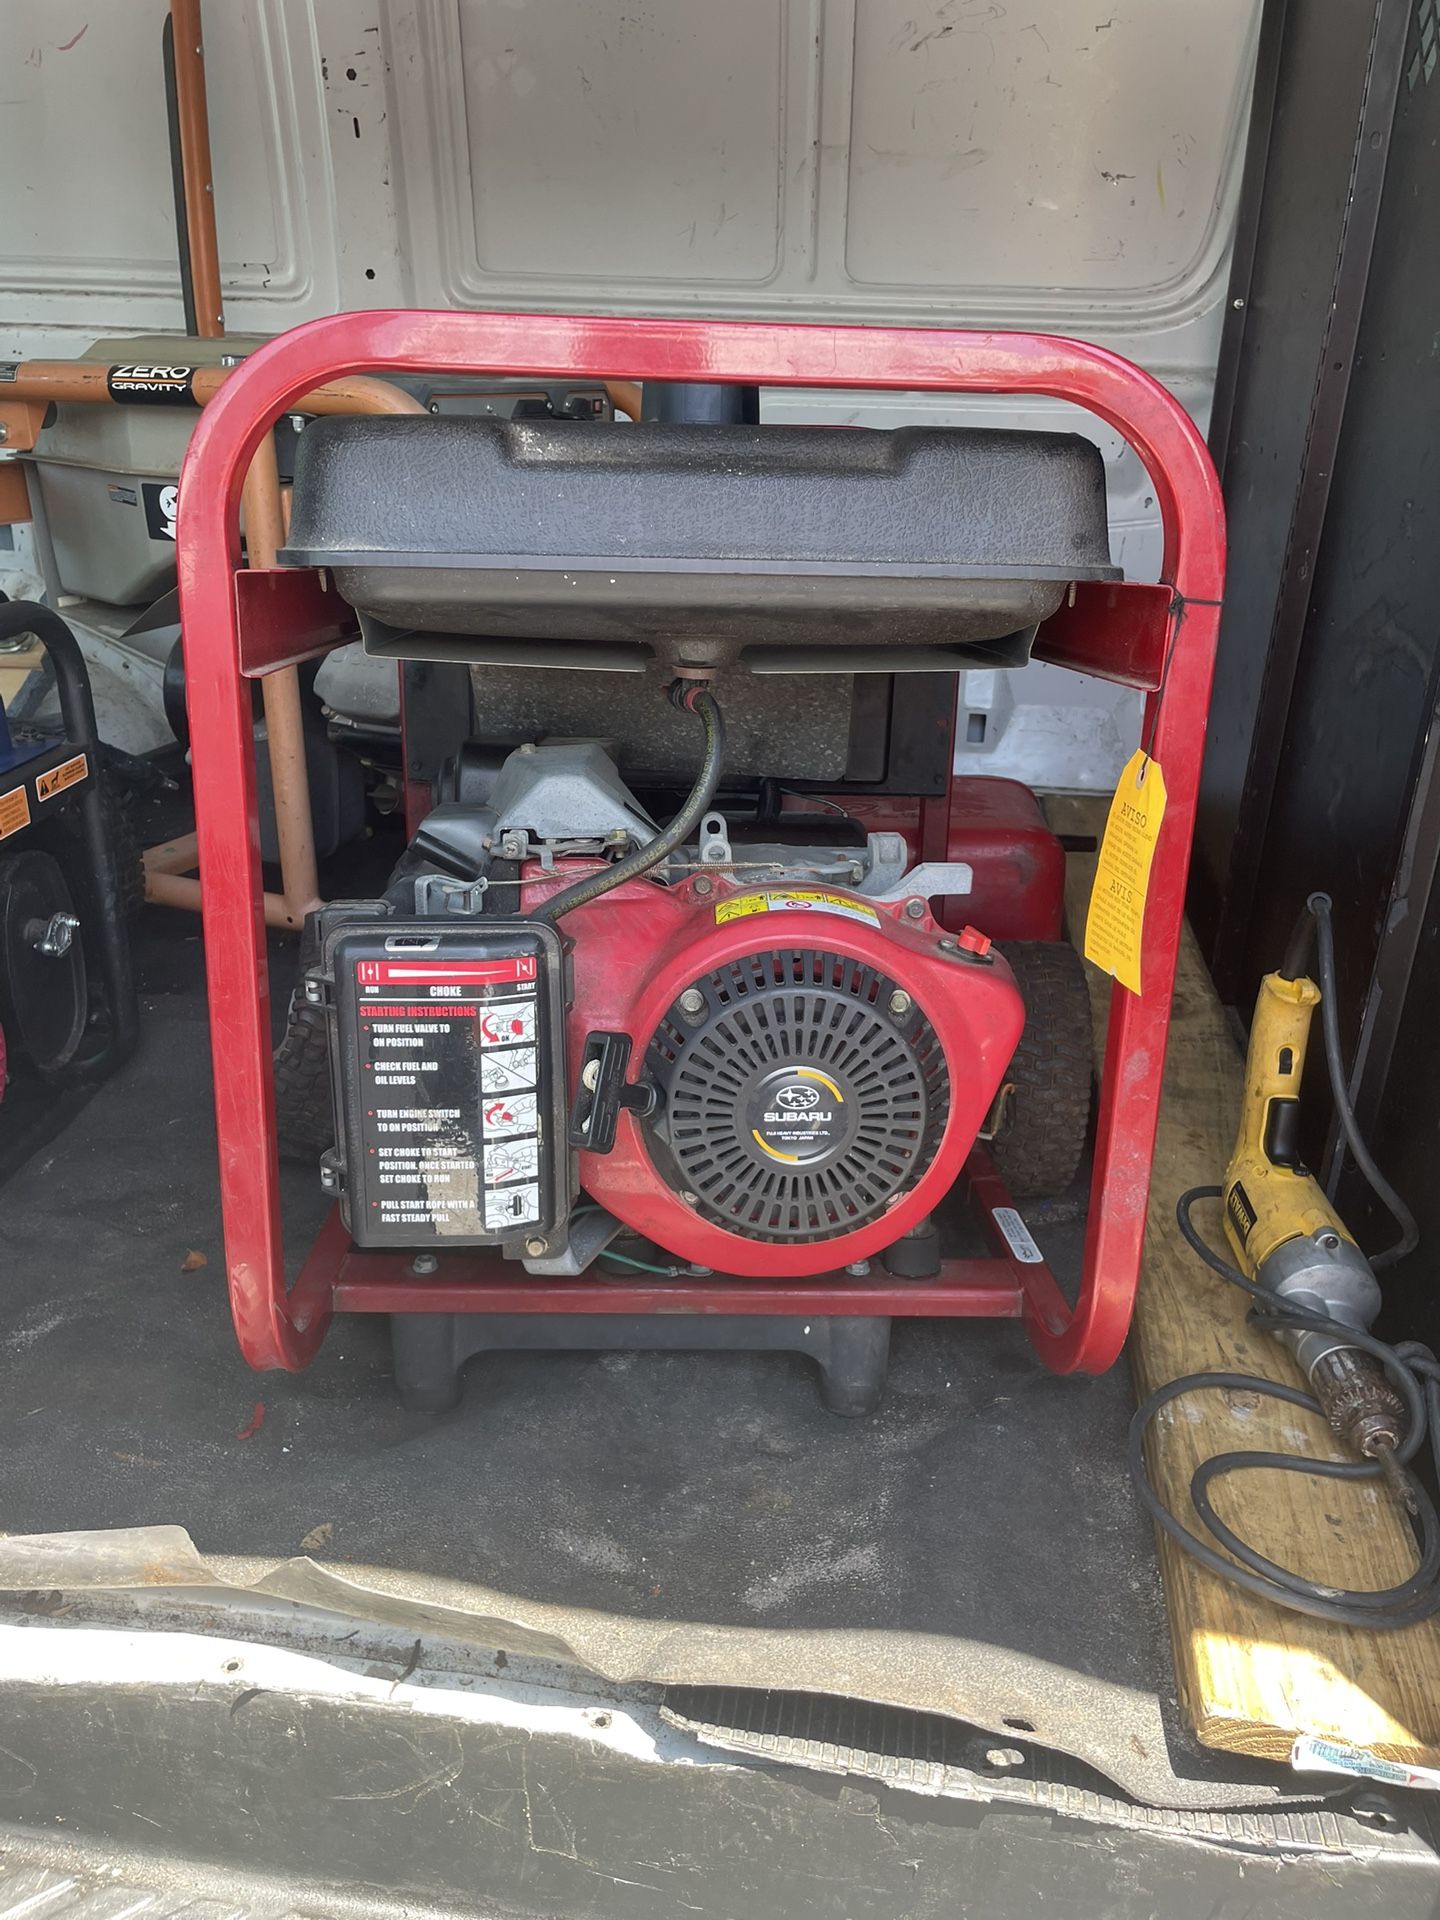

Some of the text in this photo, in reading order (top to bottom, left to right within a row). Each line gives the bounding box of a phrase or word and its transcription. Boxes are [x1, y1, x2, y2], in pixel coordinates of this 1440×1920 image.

[112, 364, 191, 379] ZERO
[112, 382, 187, 392] GRAVITY
[1120, 802, 1147, 828] AVISO
[1109, 879, 1133, 904] AVIS
[365, 982, 536, 997] RUN CHOKE START
[360, 1006, 477, 1017] STARTING INSTRUCTIONS
[372, 1024, 450, 1033] TURN FUEL VALVE TO
[373, 1038, 424, 1047] ON POSITION
[374, 1062, 438, 1071] CHECK FUEL AND
[375, 1076, 416, 1085] OIL LEVELS
[376, 1109, 460, 1118] TURN ENGINE SWITCH
[763, 1112, 832, 1122] SUBARU
[377, 1123, 438, 1132] TO ON POSITION
[378, 1148, 458, 1157] SET CHOKE TO START
[379, 1161, 475, 1170] POSITION. ONCE STARTED
[380, 1175, 450, 1183] SET CHOKE TO RUN
[381, 1200, 475, 1209] PULL START ROPE WITH A
[382, 1214, 450, 1222] FAST STEADY PULL
